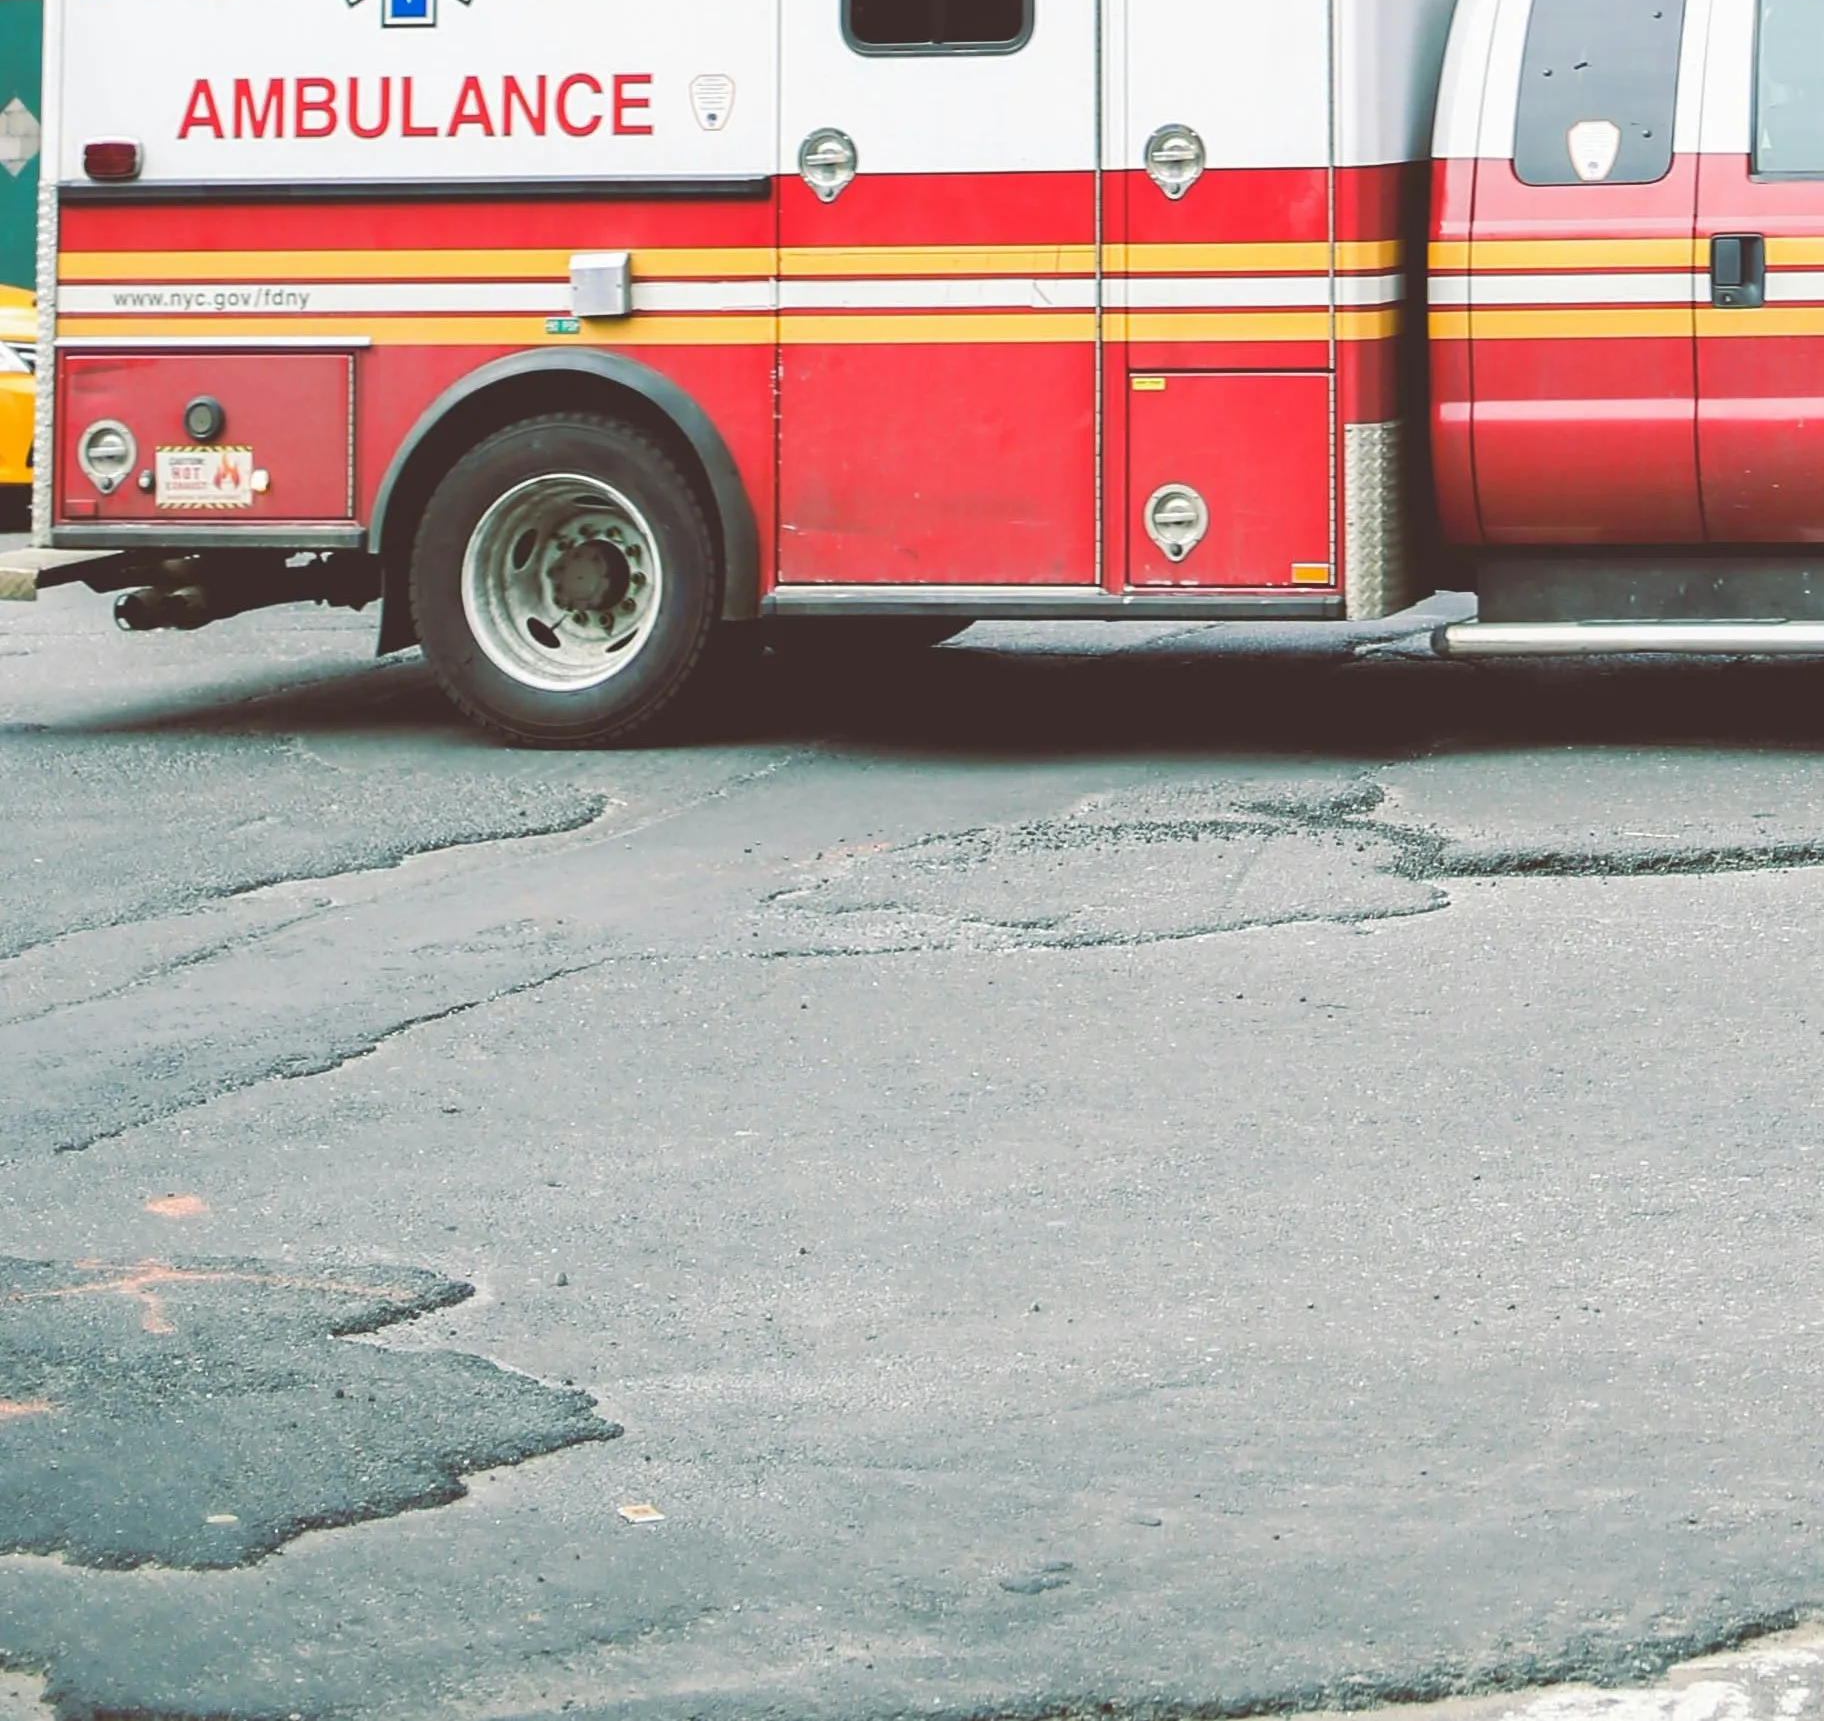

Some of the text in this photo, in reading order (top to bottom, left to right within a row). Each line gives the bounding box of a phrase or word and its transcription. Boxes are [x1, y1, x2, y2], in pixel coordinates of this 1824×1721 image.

[177, 72, 655, 140] AMBULANCE
[113, 287, 310, 311] www.nyc.gov/fdny
[172, 467, 201, 479] HOT
